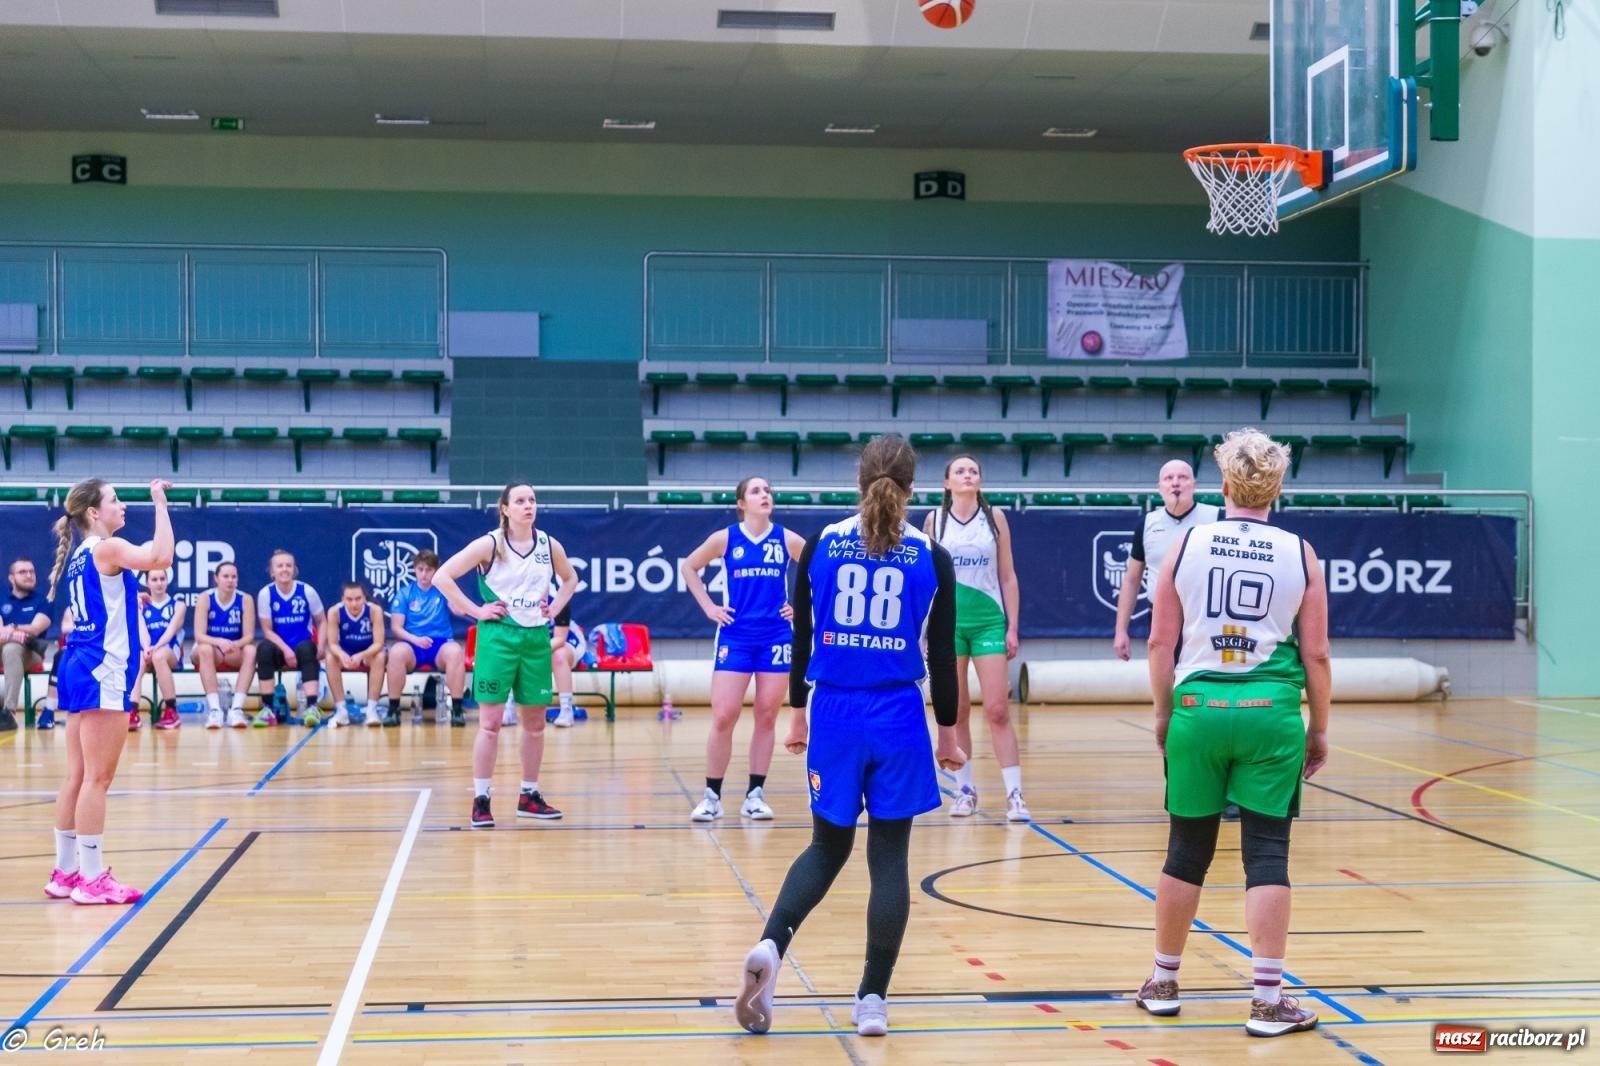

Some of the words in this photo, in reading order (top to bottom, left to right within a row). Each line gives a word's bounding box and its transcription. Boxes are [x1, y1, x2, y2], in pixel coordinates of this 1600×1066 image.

[1065, 266, 1171, 292] MIESZKO
[763, 543, 785, 564] 26
[1210, 546, 1275, 563] RACIBÓRZ
[1248, 539, 1273, 550] AZS
[741, 567, 781, 578] BETARD
[834, 563, 905, 630] 88
[1206, 566, 1275, 622] 10
[837, 632, 907, 651] BETARD
[771, 643, 792, 665] 26
